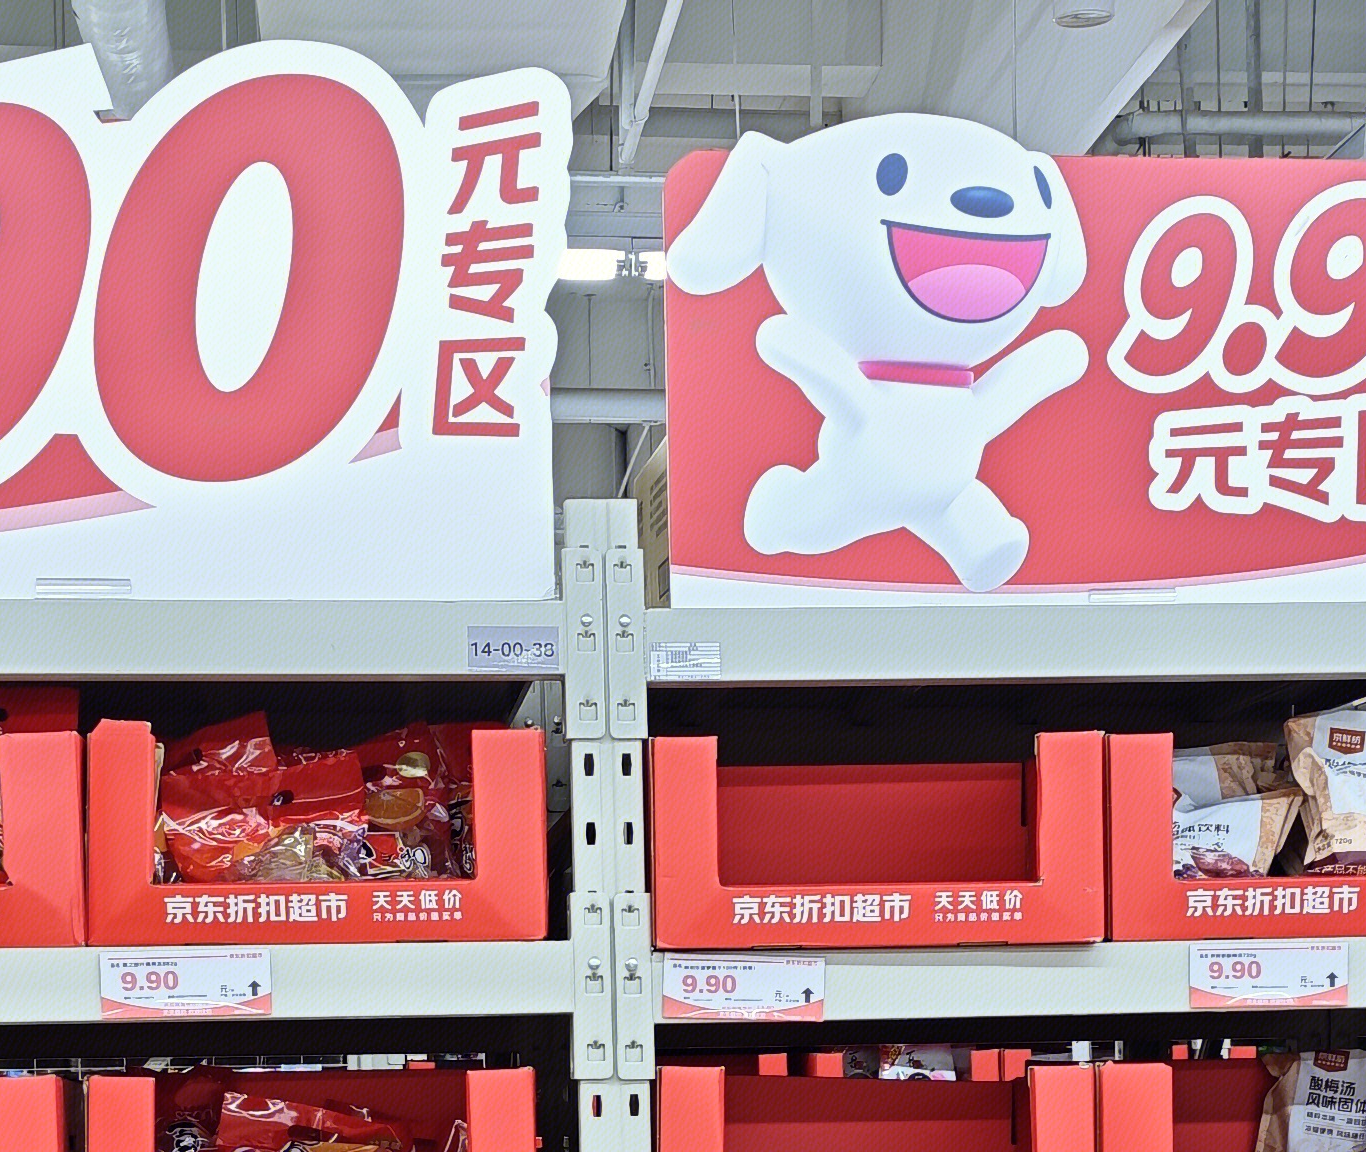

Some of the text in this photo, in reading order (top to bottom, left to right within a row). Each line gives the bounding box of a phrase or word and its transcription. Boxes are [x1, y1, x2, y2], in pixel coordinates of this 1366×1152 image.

[433, 100, 540, 438] 元专区
[164, 893, 347, 923] 京东折扣超市
[372, 890, 462, 909] 天天低价
[733, 893, 911, 924] 京东折扣超市
[935, 890, 1023, 910] 天天低价
[1187, 886, 1360, 917] 京东折扣超市
[1208, 961, 1262, 979] 9.90
[121, 971, 179, 992] 9.90
[681, 974, 737, 993] 9.90
[1309, 1076, 1356, 1096] 酸梅汤
